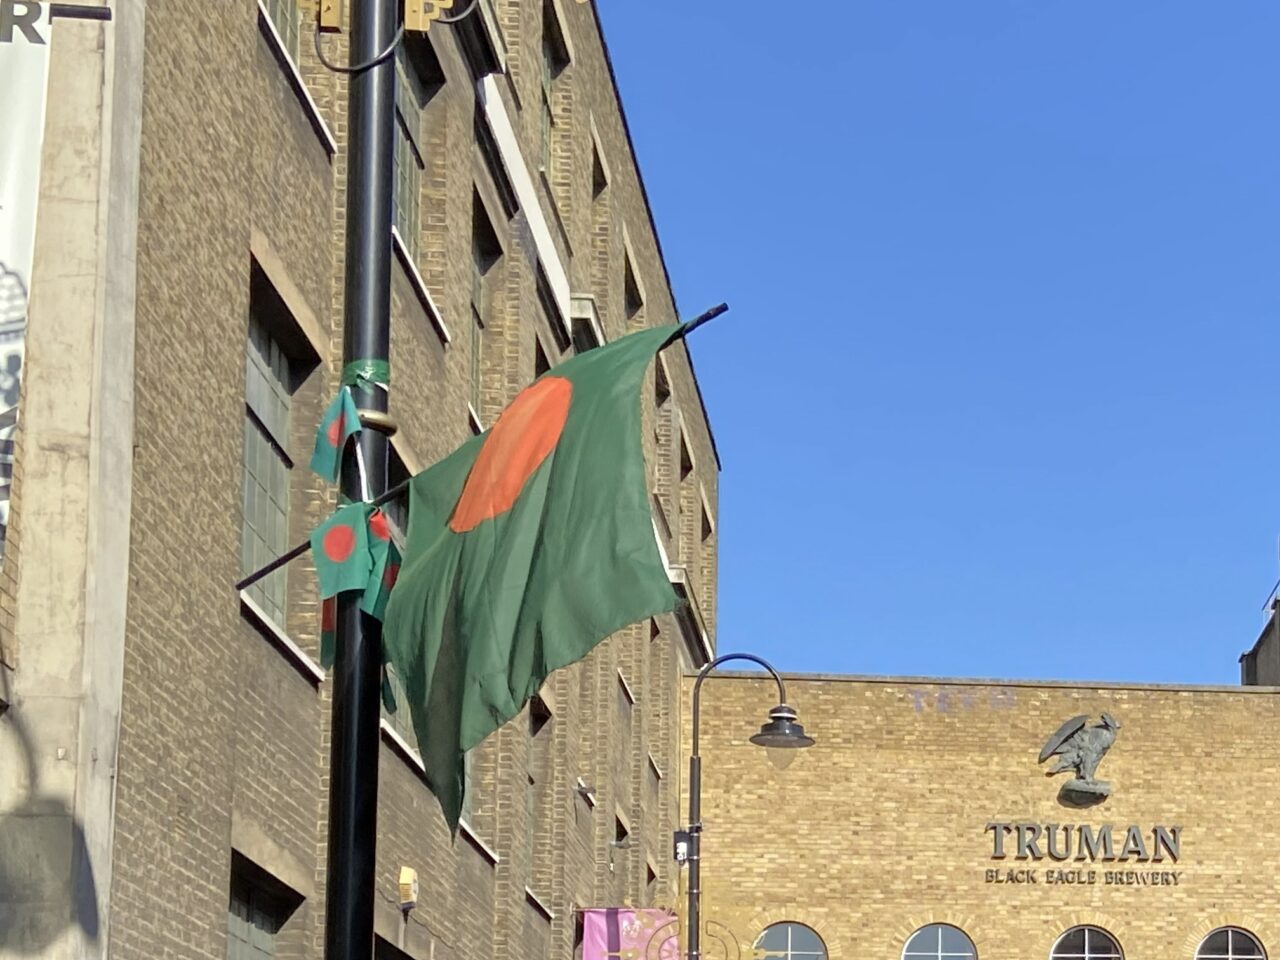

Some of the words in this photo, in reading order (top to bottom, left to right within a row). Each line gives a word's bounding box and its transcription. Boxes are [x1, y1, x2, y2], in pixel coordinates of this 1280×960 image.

[984, 822, 1183, 863] TRUMAN
[985, 868, 1037, 884] BLACK
[1046, 870, 1096, 885] EAGLE
[1105, 870, 1182, 886] BREWERY
